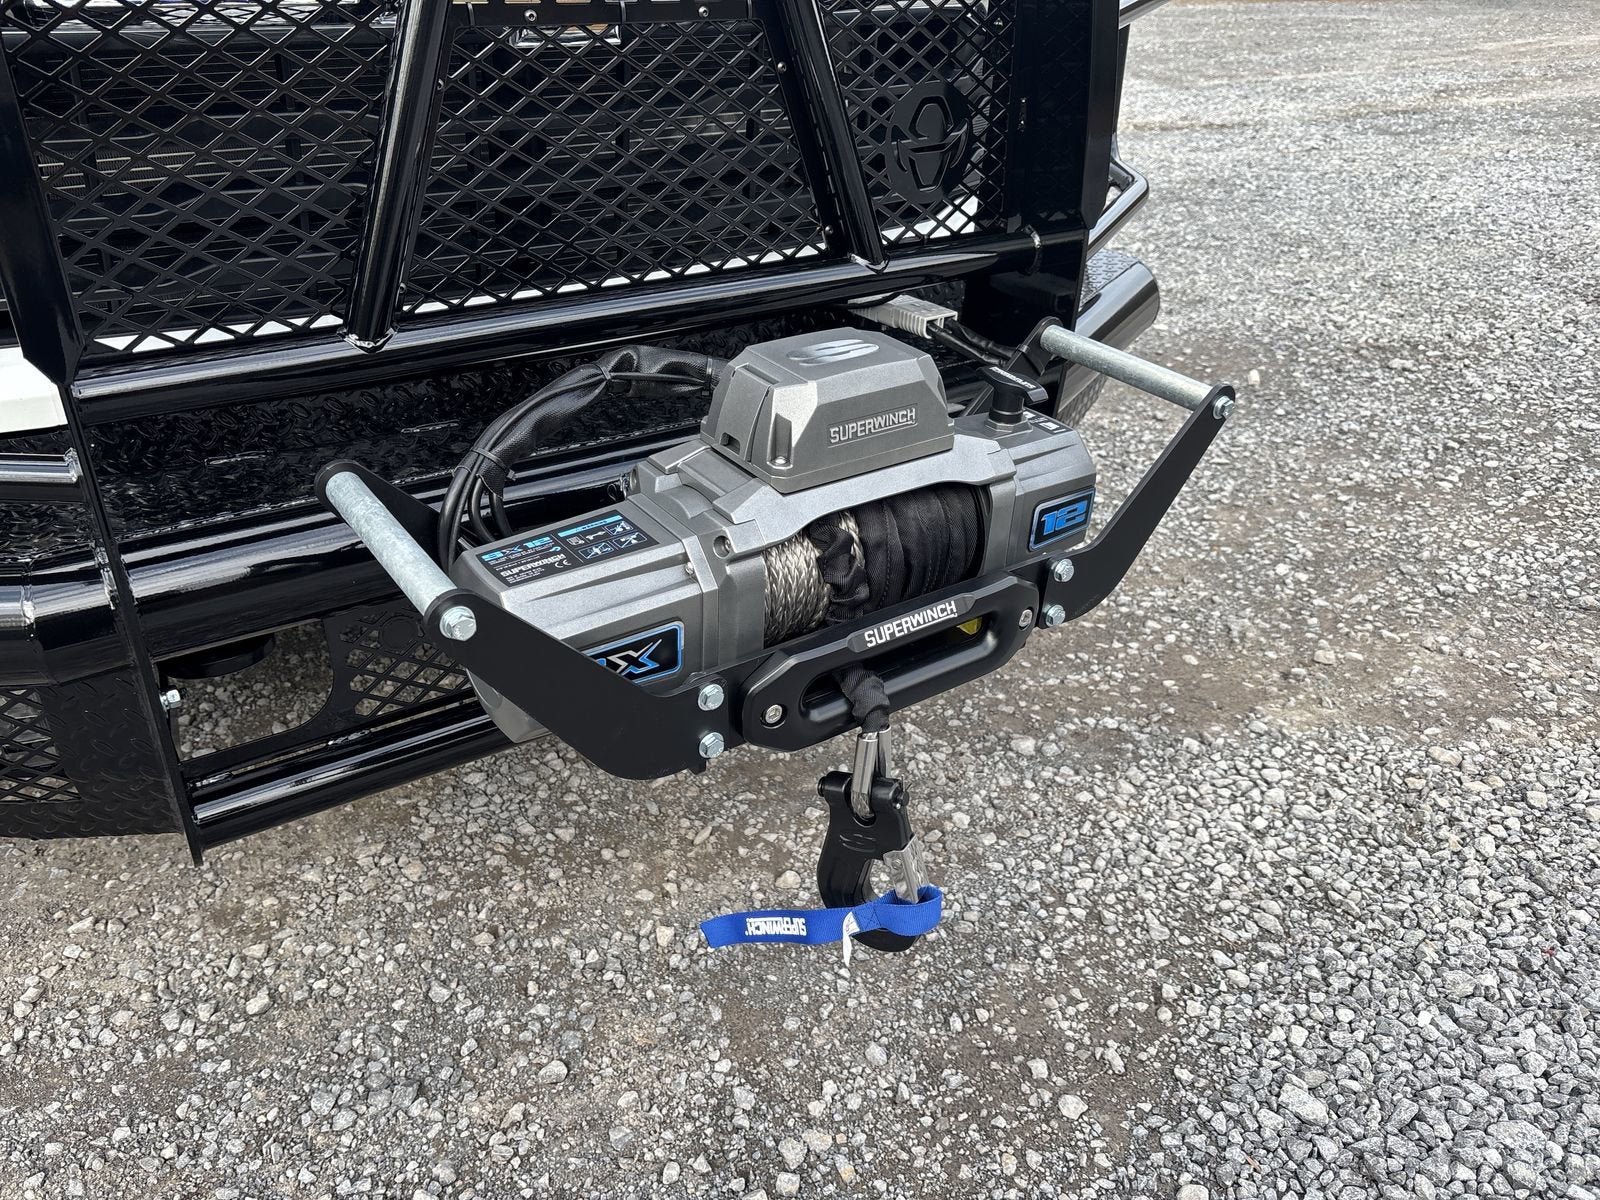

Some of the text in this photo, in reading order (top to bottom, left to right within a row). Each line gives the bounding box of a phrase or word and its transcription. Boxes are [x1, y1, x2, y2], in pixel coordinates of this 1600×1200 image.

[829, 407, 917, 444] SUPERWINCH
[1040, 500, 1088, 536] 12
[864, 600, 957, 648] SUPERWINCH
[595, 639, 662, 676] X
[745, 917, 806, 936] SUPERWINCH
